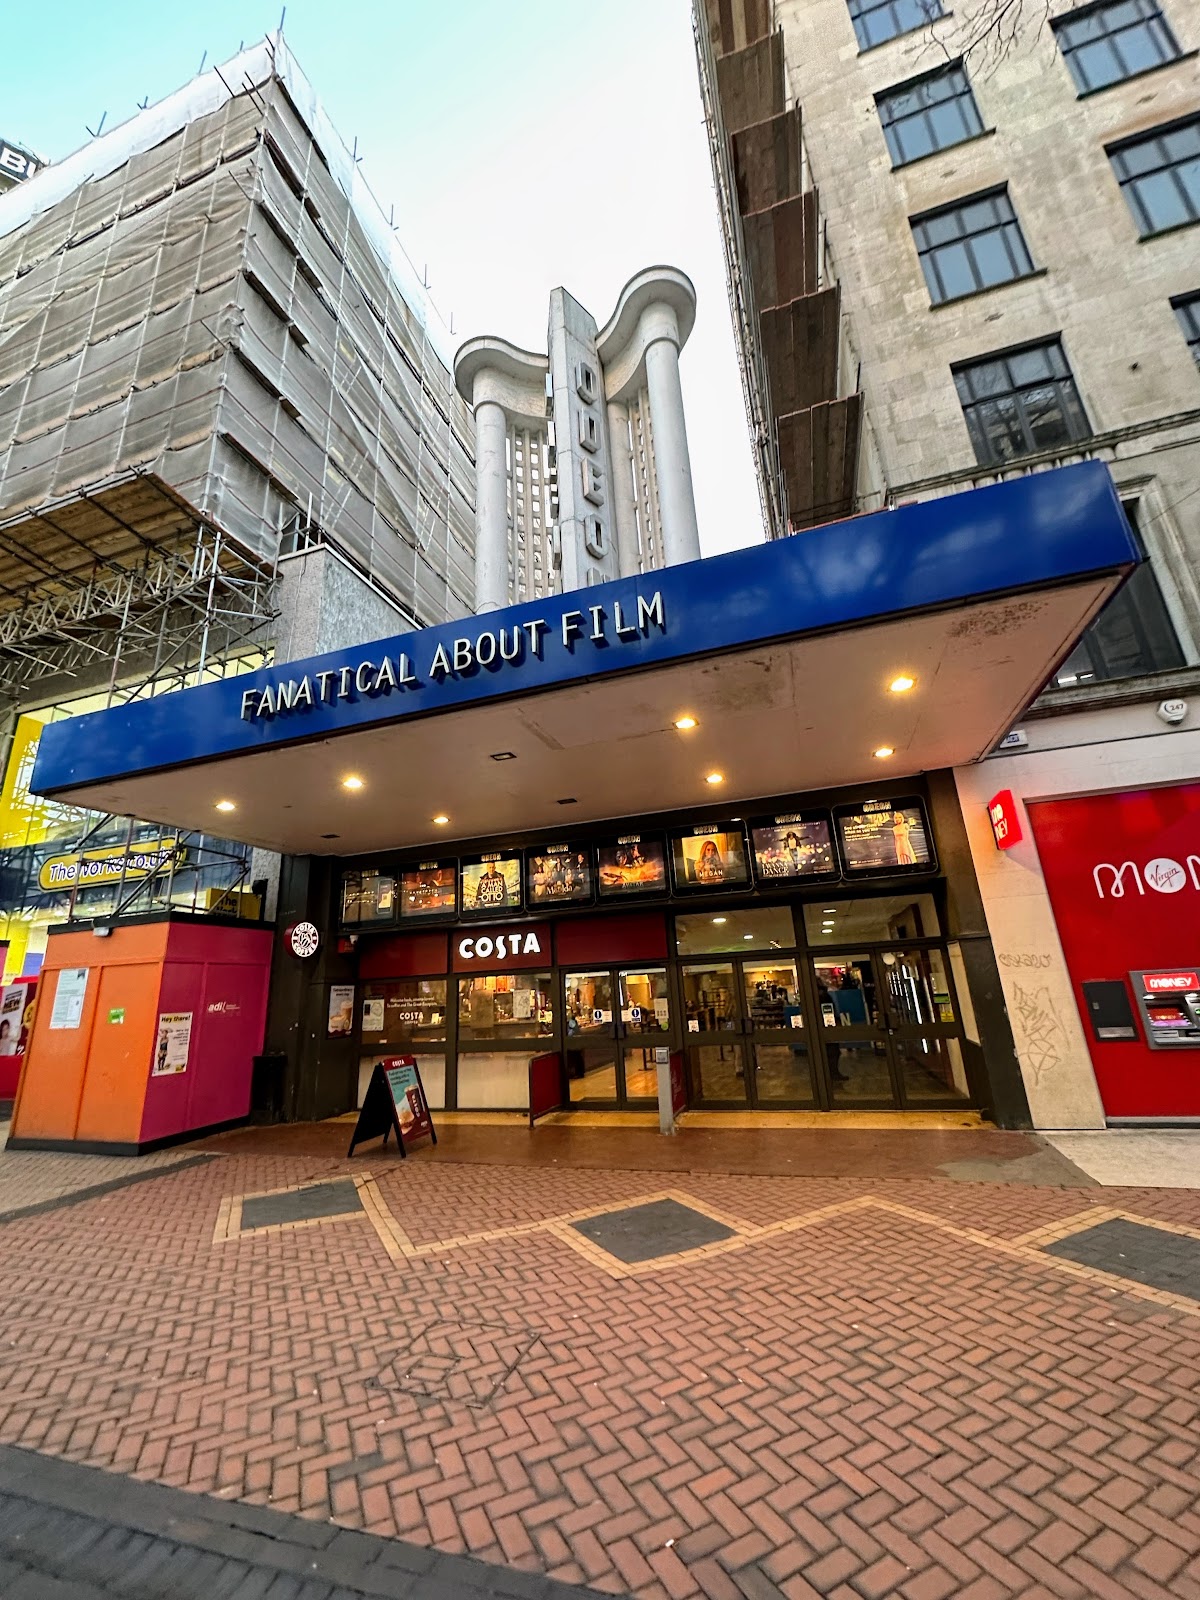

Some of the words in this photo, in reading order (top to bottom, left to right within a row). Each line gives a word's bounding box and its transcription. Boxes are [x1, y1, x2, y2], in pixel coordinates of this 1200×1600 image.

[240, 652, 416, 720] FANATICAL
[429, 618, 546, 678] ABOUT
[561, 591, 665, 648] FILM
[481, 853, 502, 862] ODEON
[763, 866, 789, 875] DANCE
[1150, 864, 1180, 888] Virgin
[489, 879, 502, 887] MAN
[481, 885, 503, 894] CALLED
[481, 892, 503, 902] OTTO
[293, 923, 317, 934] COSTA
[459, 932, 541, 960] COSTA
[1149, 977, 1192, 989] MONEY
[400, 1011, 423, 1021] COSTA
[392, 1059, 405, 1067] COSTA
